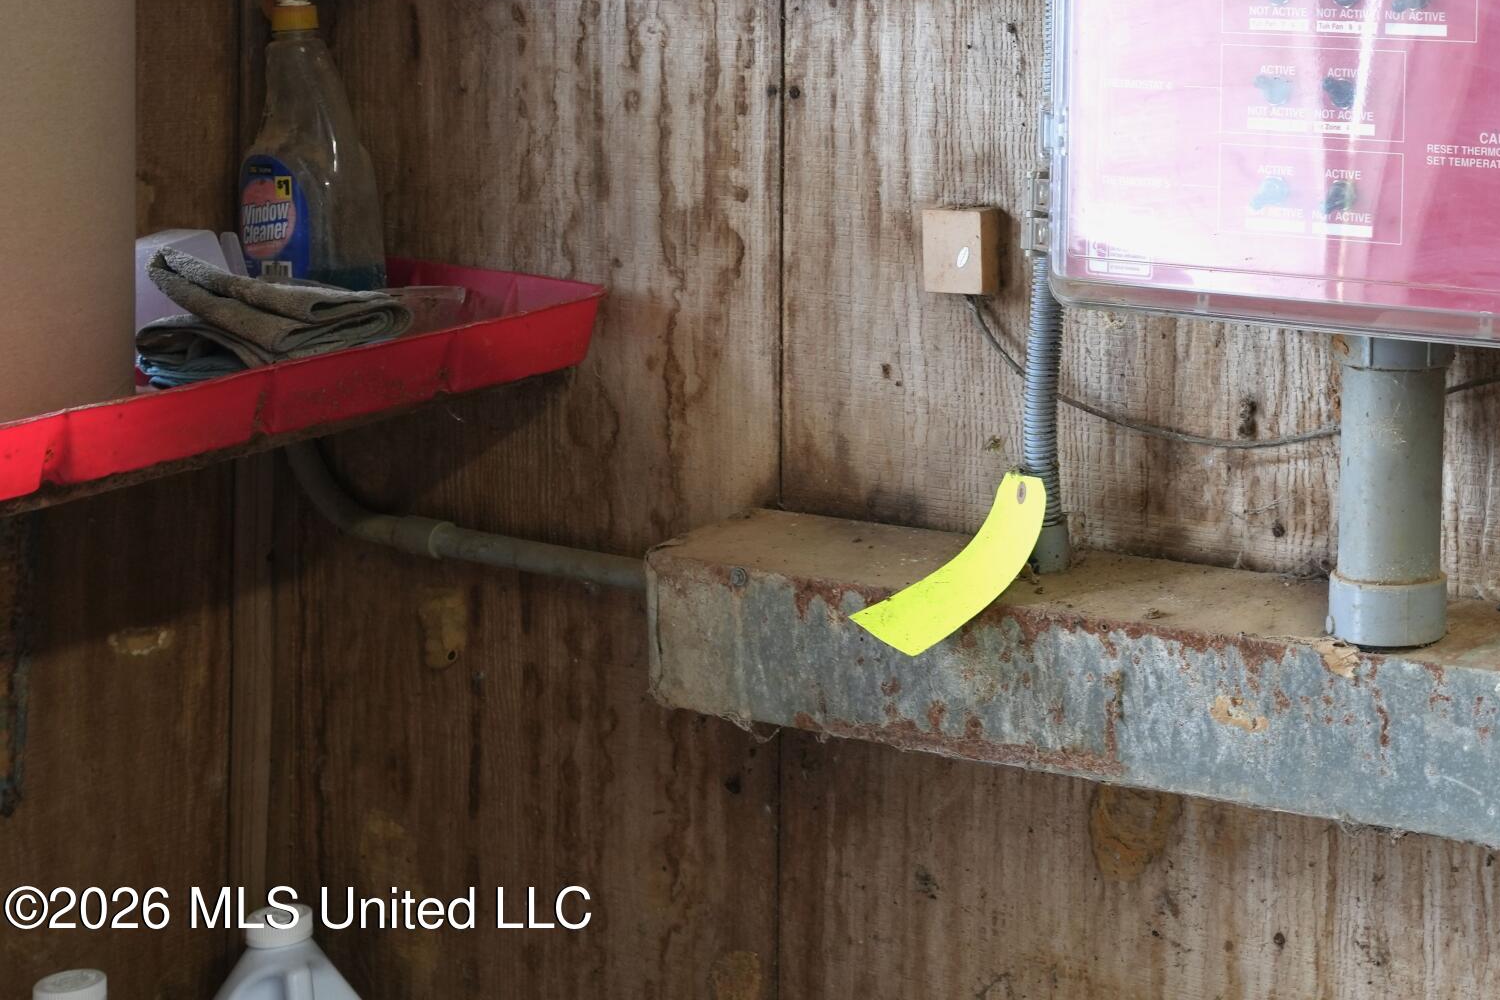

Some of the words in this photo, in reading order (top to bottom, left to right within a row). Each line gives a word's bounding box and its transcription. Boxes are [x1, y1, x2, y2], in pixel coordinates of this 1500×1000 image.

[1427, 144, 1460, 154] RESET
[1426, 155, 1447, 166] SET
[277, 179, 290, 196] $1
[243, 202, 289, 224] Window
